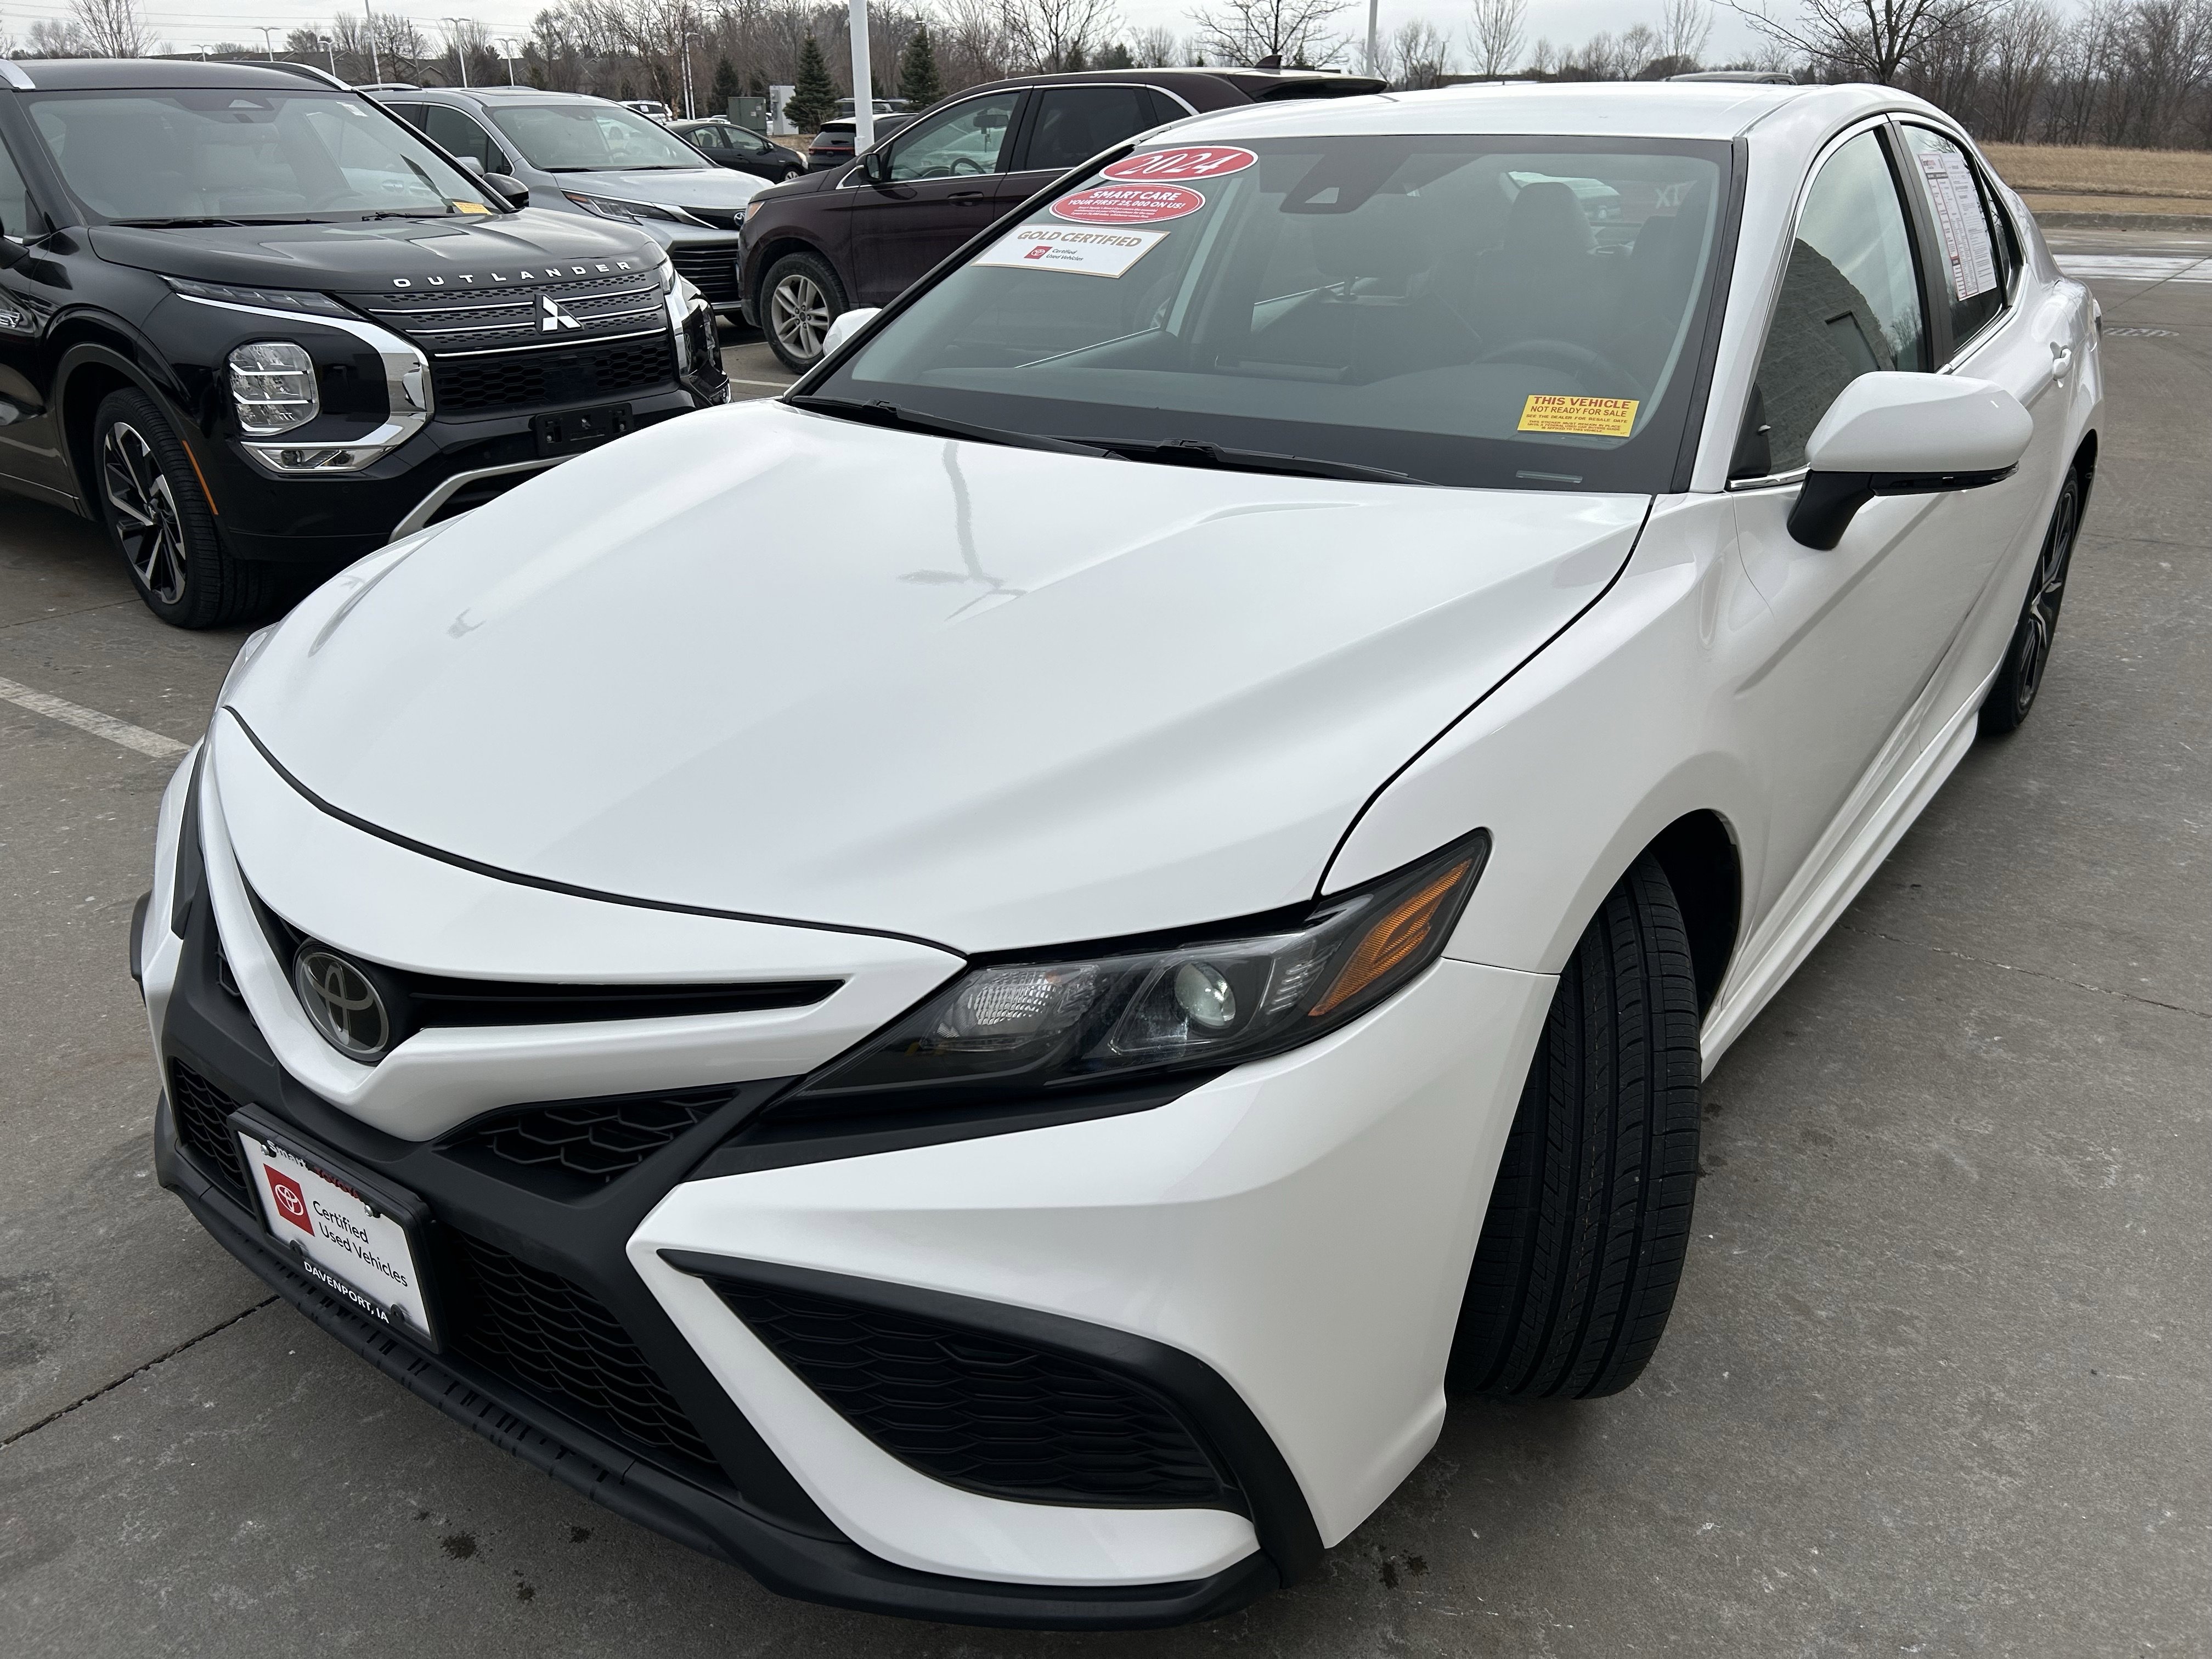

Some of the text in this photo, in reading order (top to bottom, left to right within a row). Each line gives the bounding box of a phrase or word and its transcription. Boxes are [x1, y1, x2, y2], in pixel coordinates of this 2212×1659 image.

[1115, 153, 1245, 176] 2024
[1089, 191, 1182, 201] SMART CARE
[1017, 231, 1142, 247] GOLD CERTIFIED
[393, 261, 631, 287] OUTLANDER
[1533, 396, 1631, 409] THIS VEHICLE
[313, 1200, 369, 1244] Certified
[318, 1223, 408, 1287] Used Vehicles
[303, 1261, 390, 1324] DAVENPORT, IA
